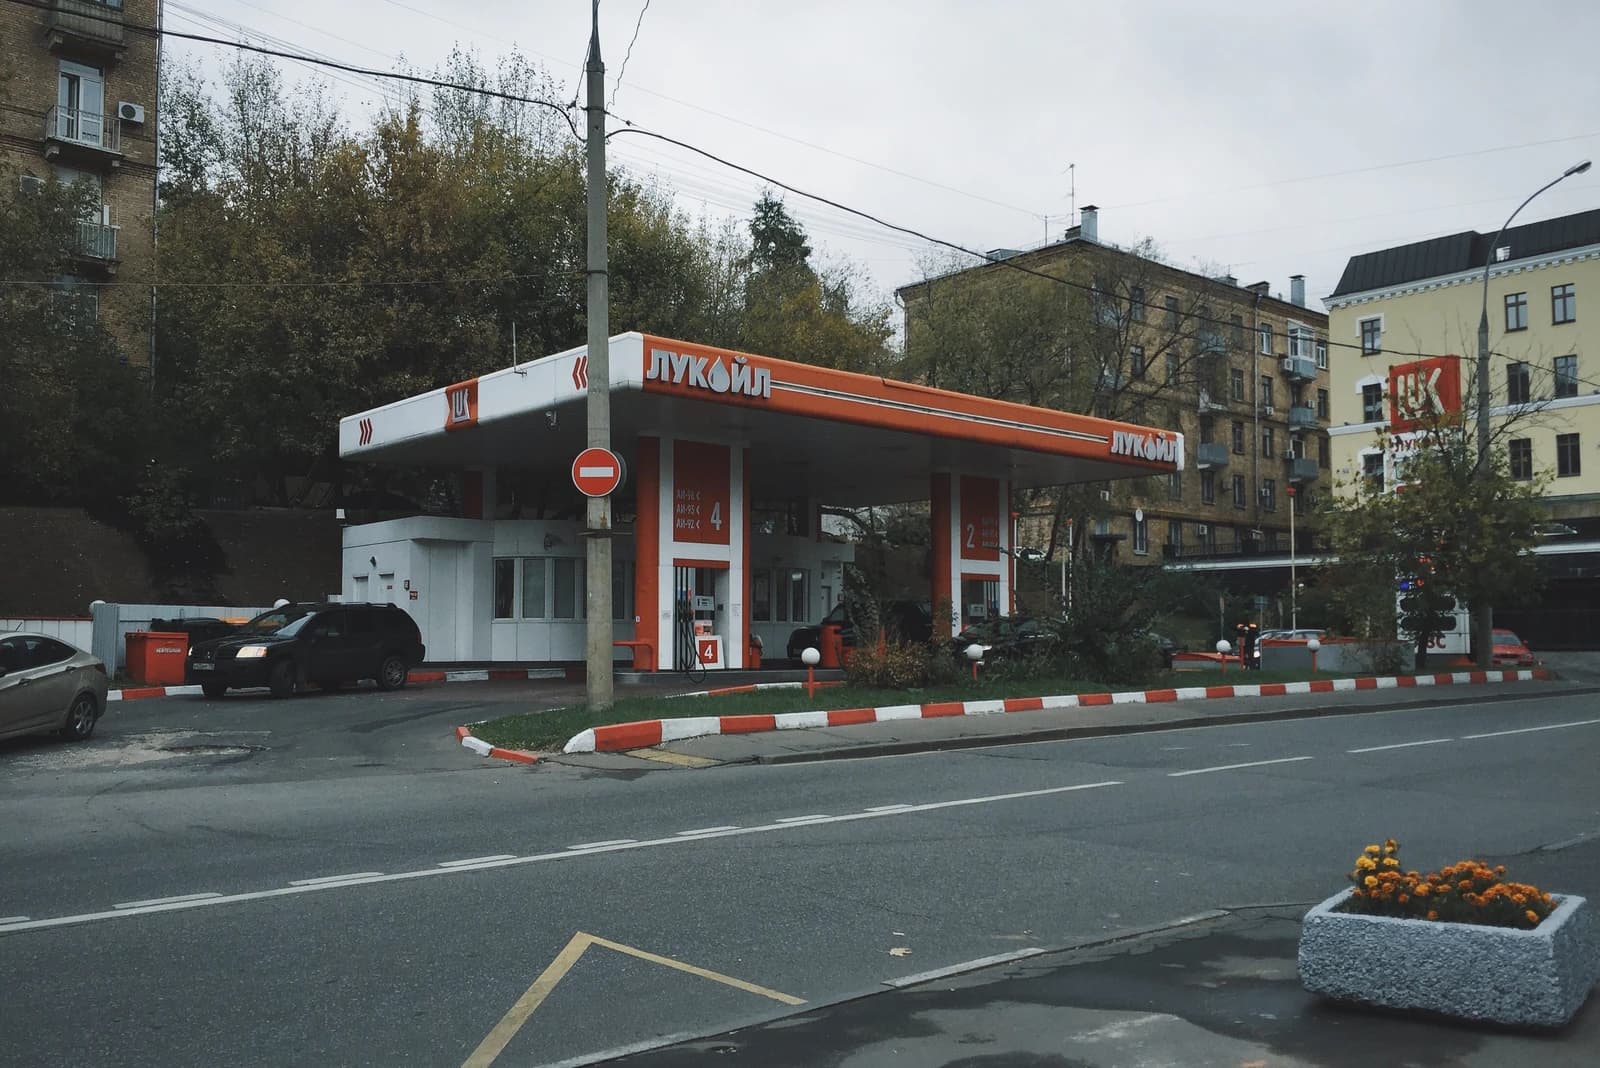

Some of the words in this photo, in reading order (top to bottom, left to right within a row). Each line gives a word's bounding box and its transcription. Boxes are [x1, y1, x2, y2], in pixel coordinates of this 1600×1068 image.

[646, 348, 771, 398] ЛУКОЙЛ
[1111, 430, 1179, 463] ЛУКОЙЛ
[710, 502, 722, 531] 4
[966, 524, 975, 548] 2
[704, 644, 713, 660] 4
